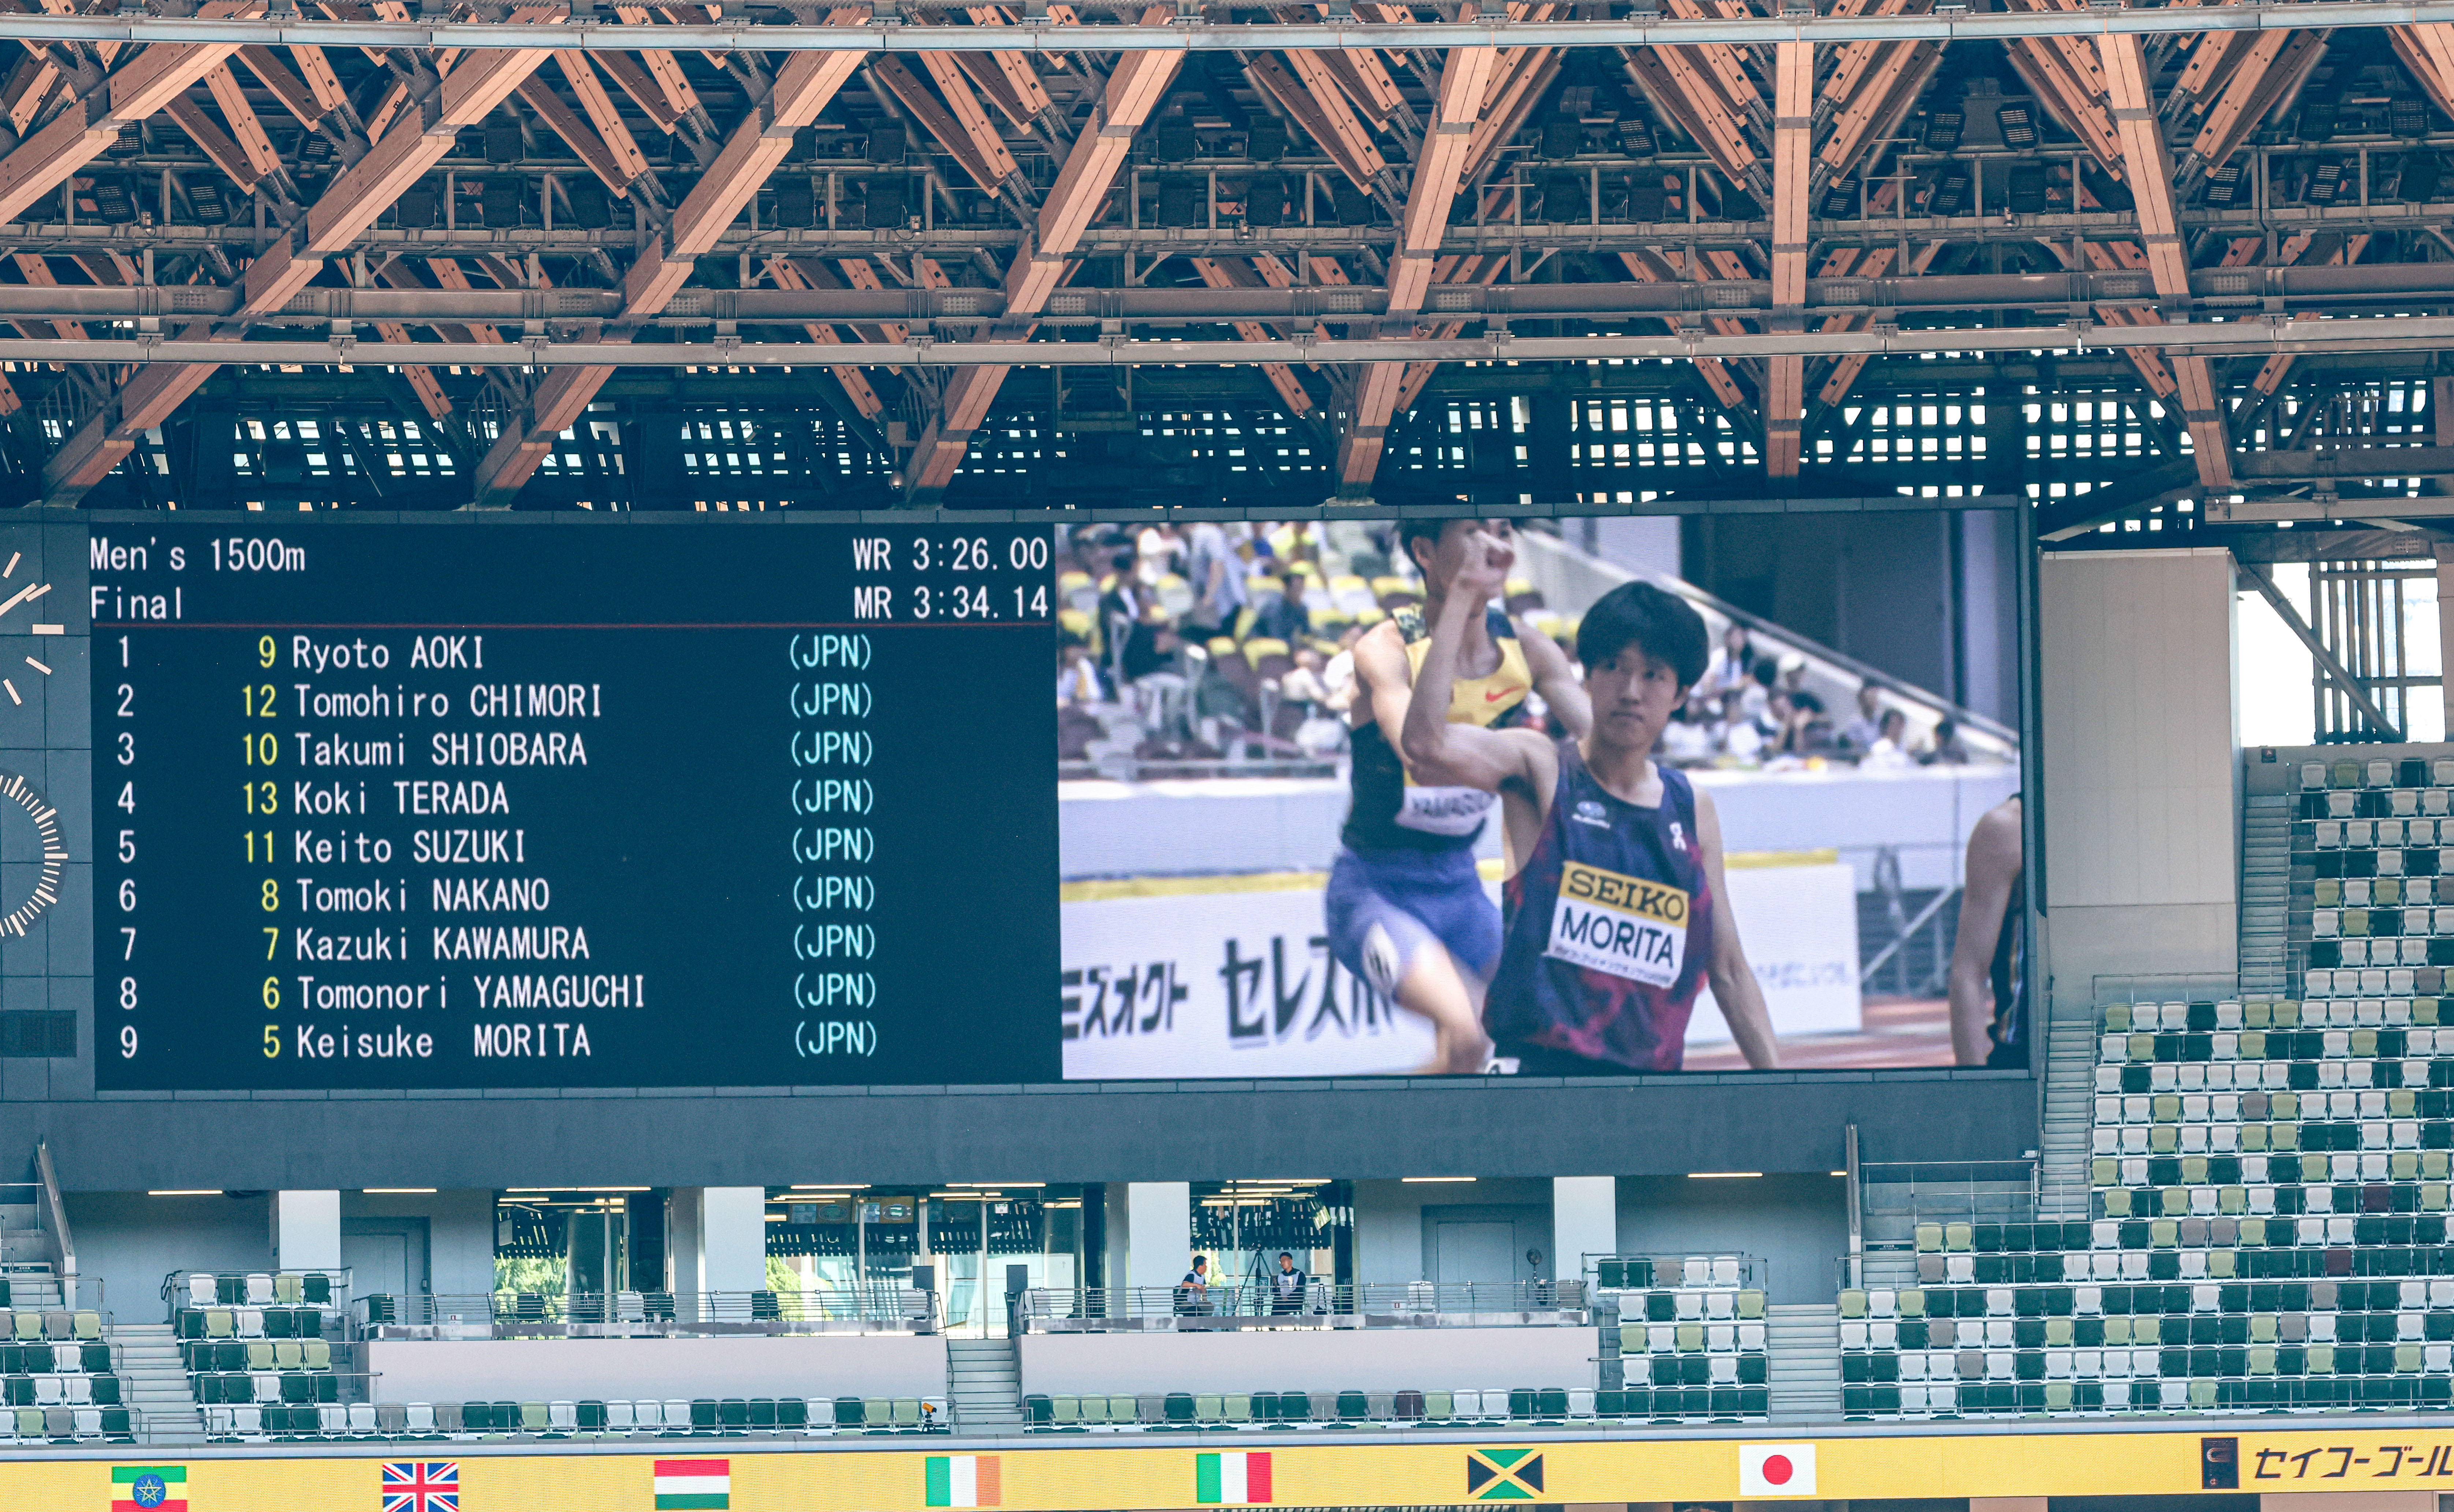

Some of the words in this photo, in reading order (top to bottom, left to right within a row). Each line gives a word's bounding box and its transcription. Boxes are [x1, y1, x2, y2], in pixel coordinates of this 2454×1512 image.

[91, 537, 185, 570] Men's
[212, 538, 305, 571] 1500m
[853, 538, 891, 571] WR
[913, 537, 1048, 570] 3:26.00
[91, 586, 181, 619] Final
[854, 586, 891, 619] MR
[914, 585, 1048, 619] 3:34.14
[119, 636, 128, 667] 1
[259, 635, 275, 668] 9
[293, 636, 389, 673] Ryoto
[411, 636, 483, 668] AOKI
[790, 634, 871, 670] (JPN)
[118, 684, 133, 716] 2
[243, 684, 276, 717] 12
[294, 684, 448, 717] Tomohiro
[470, 684, 600, 717] CHIMORI
[791, 682, 872, 718] (JPN)
[118, 732, 134, 765] 3
[243, 733, 277, 766] 10
[295, 733, 403, 766] Takumi
[432, 733, 586, 766] SHIOBARA
[792, 730, 872, 767] (JPN)
[118, 781, 135, 814] 4
[243, 782, 277, 814] 13
[295, 781, 365, 814] Koki
[394, 781, 509, 814] TERADA
[792, 779, 873, 815] (JPN)
[119, 830, 135, 863] 5
[244, 830, 273, 863] 11
[295, 830, 391, 863] Keito
[413, 830, 524, 863] SUZUKI
[793, 827, 874, 863] (JPN)
[119, 879, 135, 911] 6
[262, 879, 279, 911] 8
[297, 879, 405, 912] Tomoki
[433, 878, 549, 911] NAKANO
[794, 876, 874, 912] (JPN)
[1568, 869, 1684, 921] SEIKO
[121, 928, 135, 960] 7
[263, 927, 279, 960] 7
[297, 927, 406, 961] Kazuki
[434, 926, 589, 960] KAWAMURA
[794, 924, 875, 960] (JPN)
[1560, 906, 1673, 969] MORITA
[120, 977, 137, 1009] 8
[263, 976, 280, 1009] 6
[298, 976, 446, 1009] Tomonori
[474, 975, 644, 1008] YAMAGUCHI
[794, 972, 876, 1009] (JPN)
[120, 1025, 137, 1058] 9
[264, 1025, 280, 1058] 5
[298, 1025, 432, 1058] Keisuke
[474, 1023, 591, 1057] MORITA
[795, 1021, 876, 1057] (JPN)
[2255, 1445, 2454, 1478] セイコーゴール
